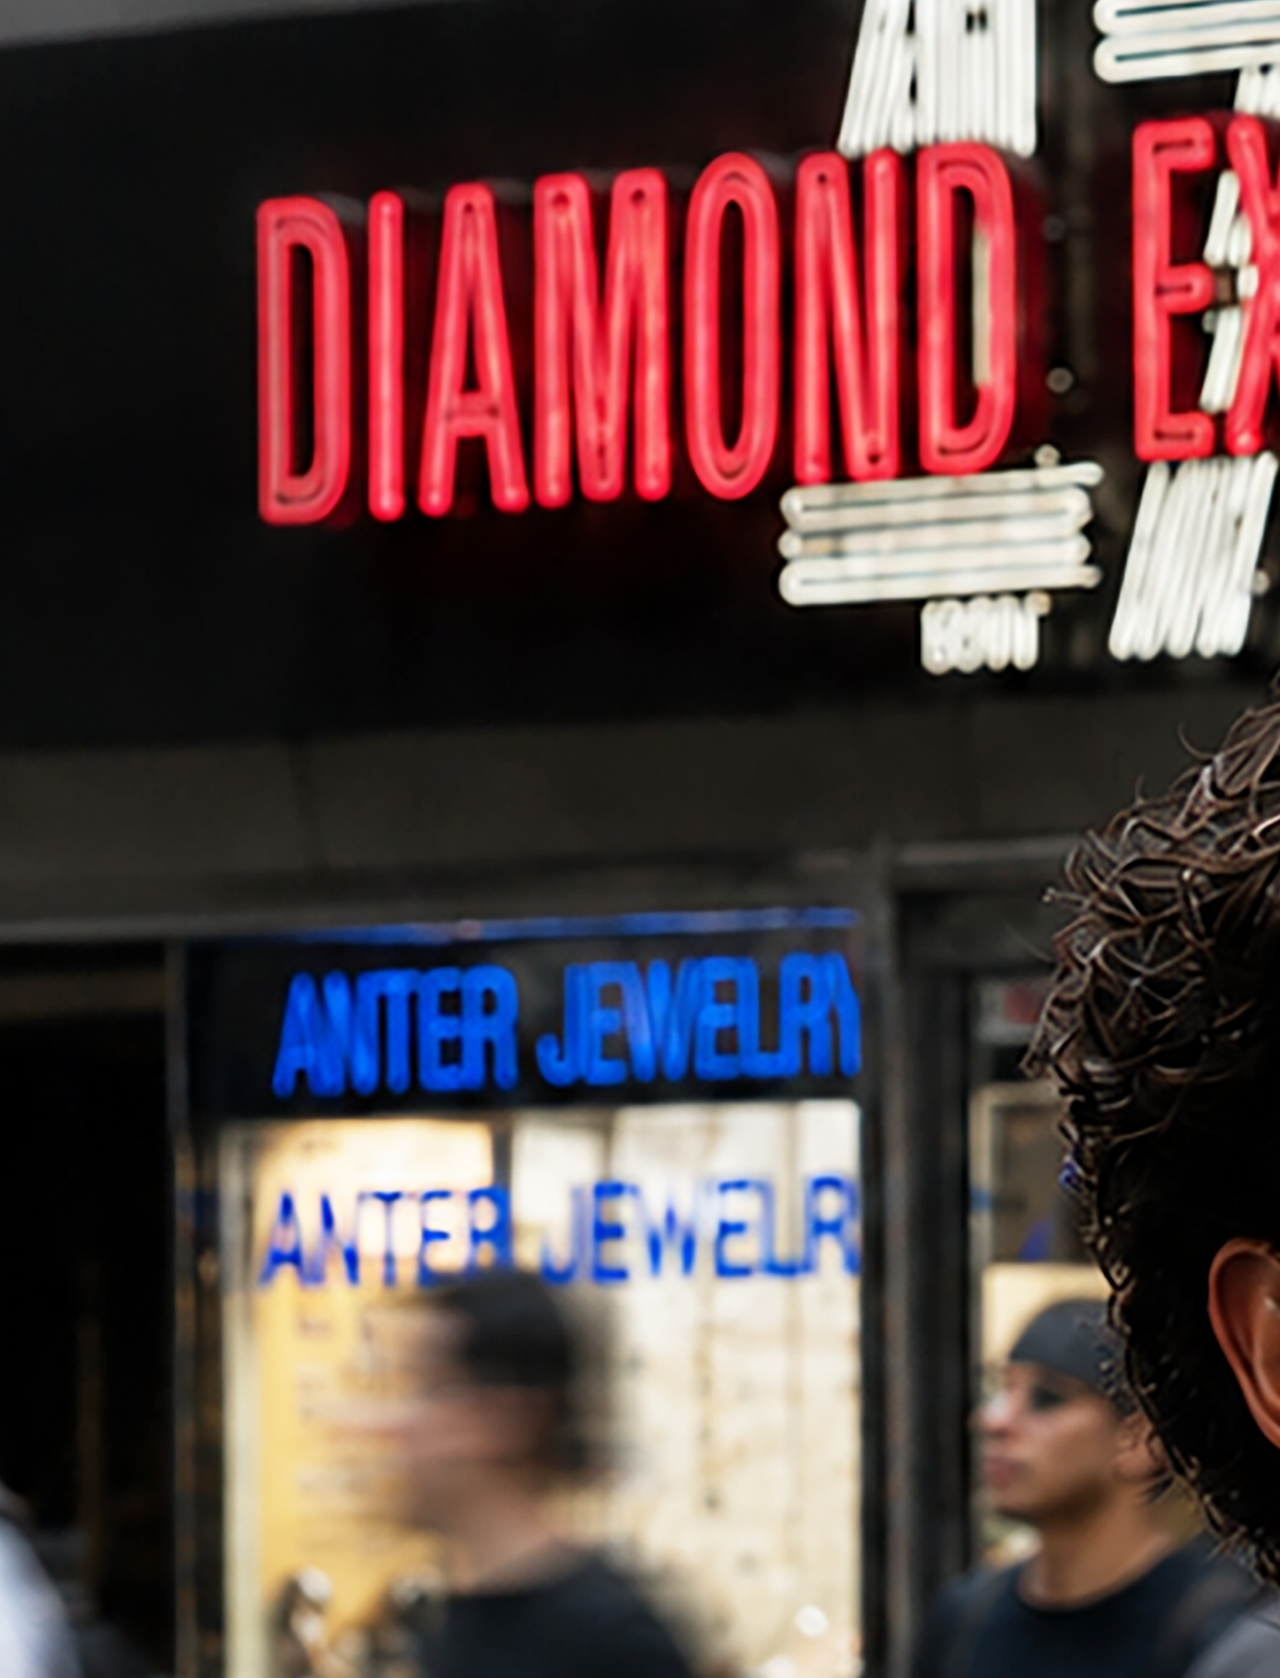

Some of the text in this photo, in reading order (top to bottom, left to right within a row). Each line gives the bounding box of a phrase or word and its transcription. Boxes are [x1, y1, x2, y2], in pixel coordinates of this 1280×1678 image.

[255, 137, 1025, 525] DIAMOND
[272, 965, 519, 1095] ANTER
[261, 1183, 514, 1286] ANTER
